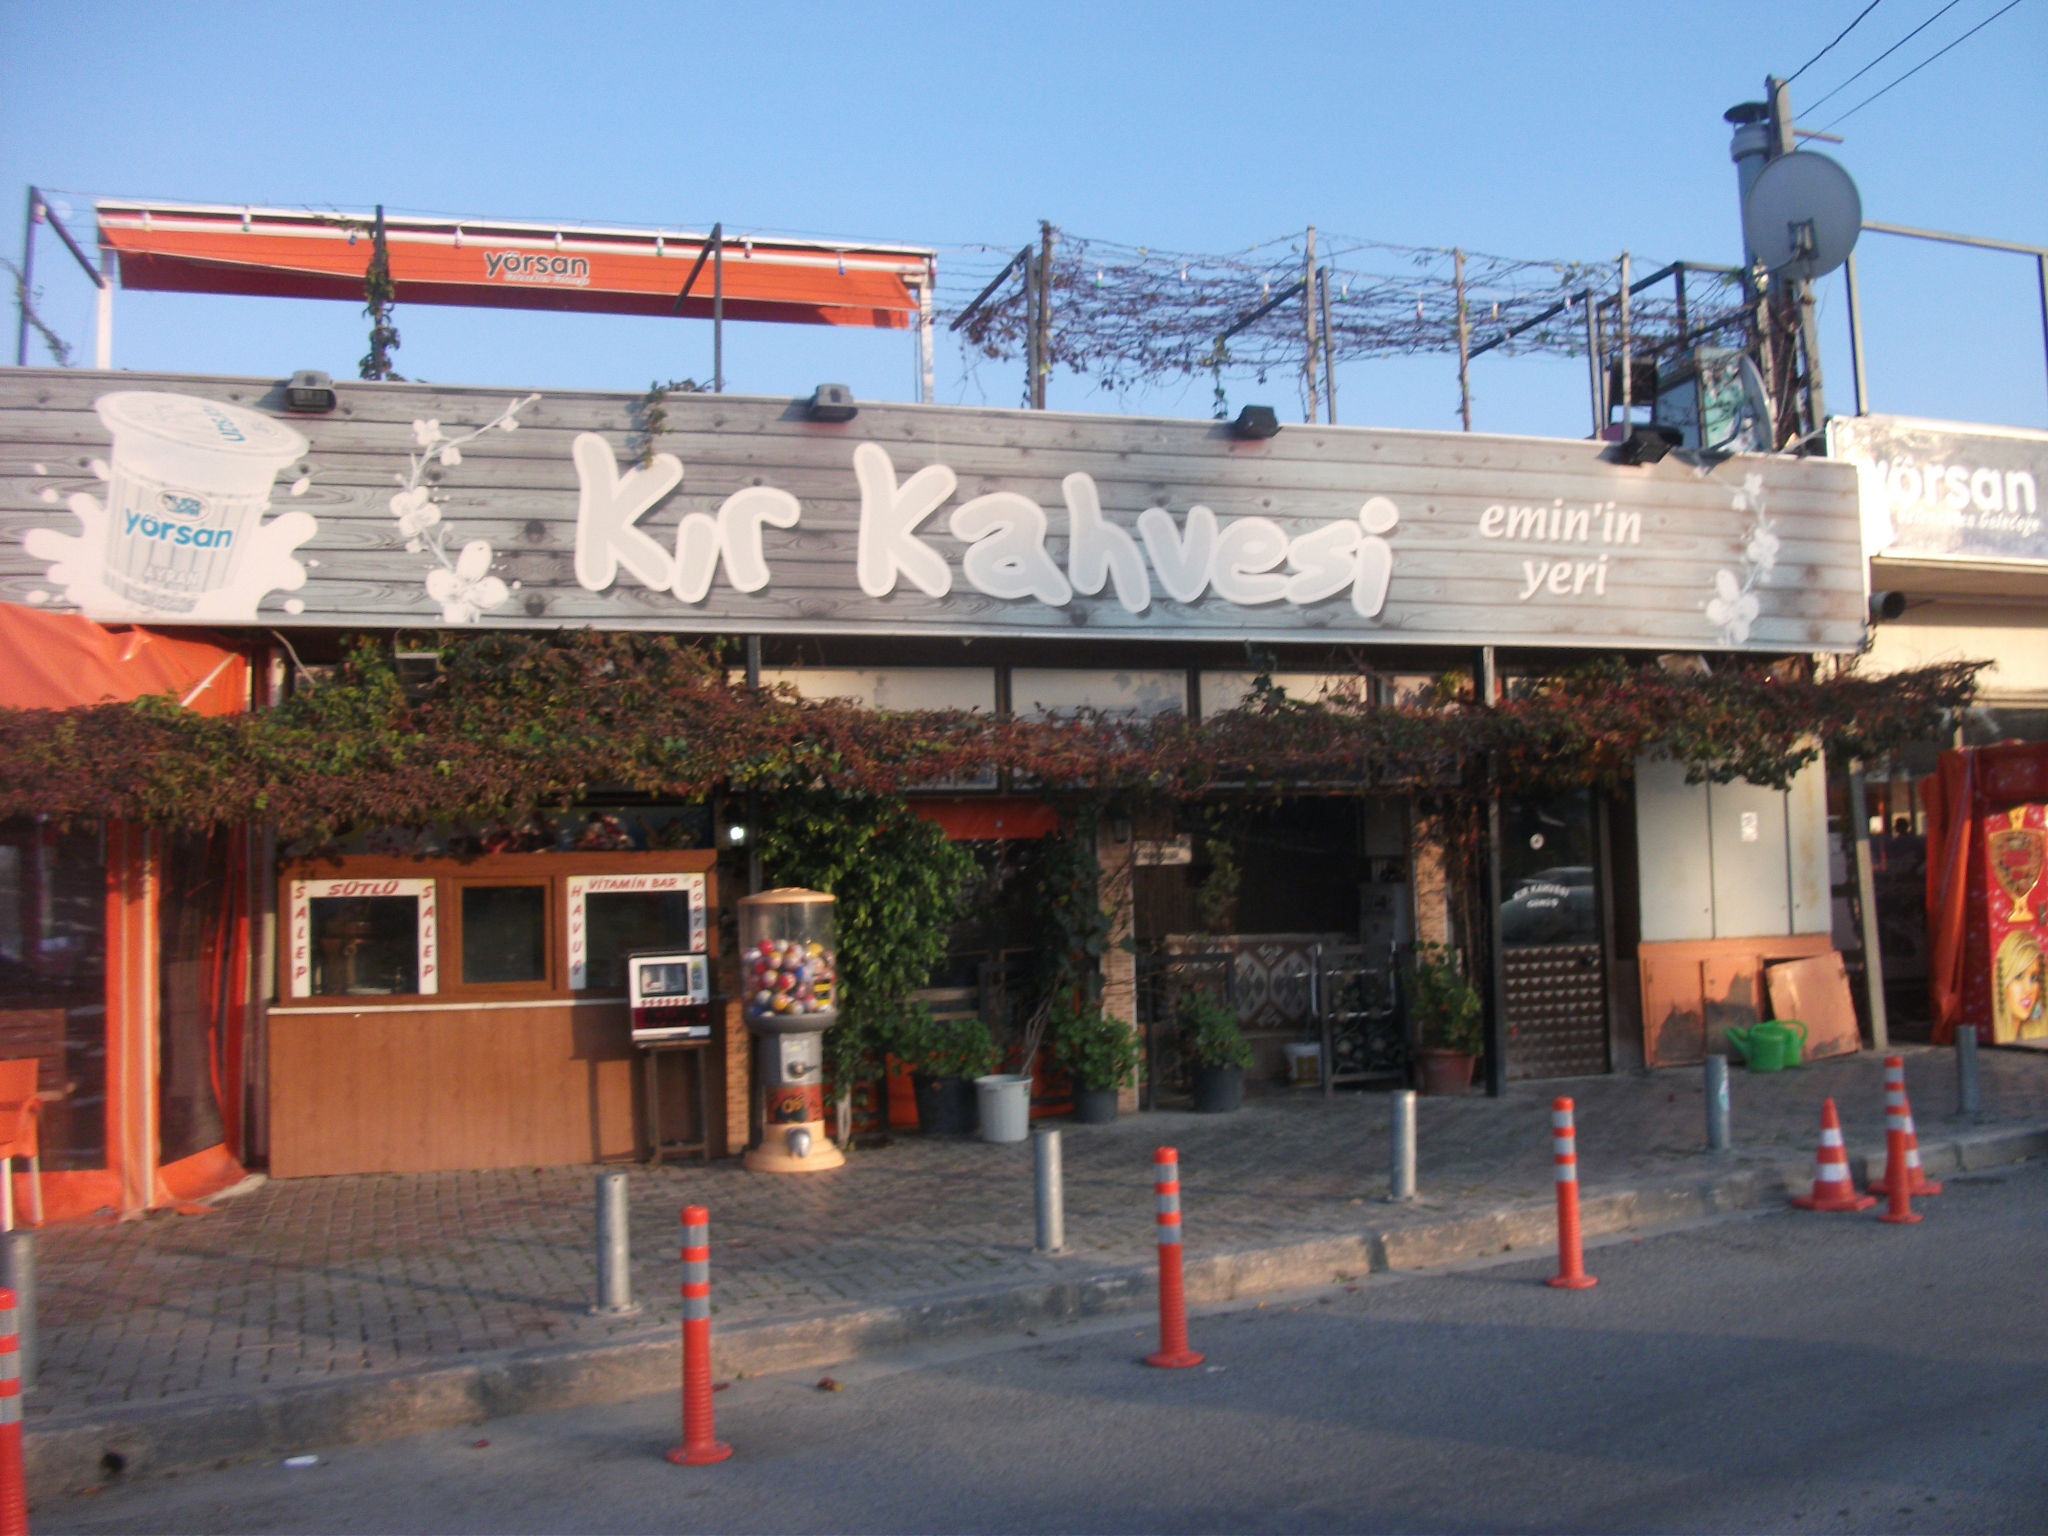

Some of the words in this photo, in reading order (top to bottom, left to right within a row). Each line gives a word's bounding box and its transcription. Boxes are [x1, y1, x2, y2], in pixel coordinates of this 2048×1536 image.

[485, 251, 589, 278] yörsan
[125, 508, 233, 548] yörsan
[571, 431, 802, 604] Kır
[853, 441, 1400, 618] Kahvesi
[1478, 498, 1643, 544] emin'in
[1519, 553, 1609, 601] yeri
[328, 880, 400, 897] SÜTLÜ
[651, 877, 678, 888] BAR
[295, 885, 308, 980] SALEP
[422, 884, 436, 978] SALEP
